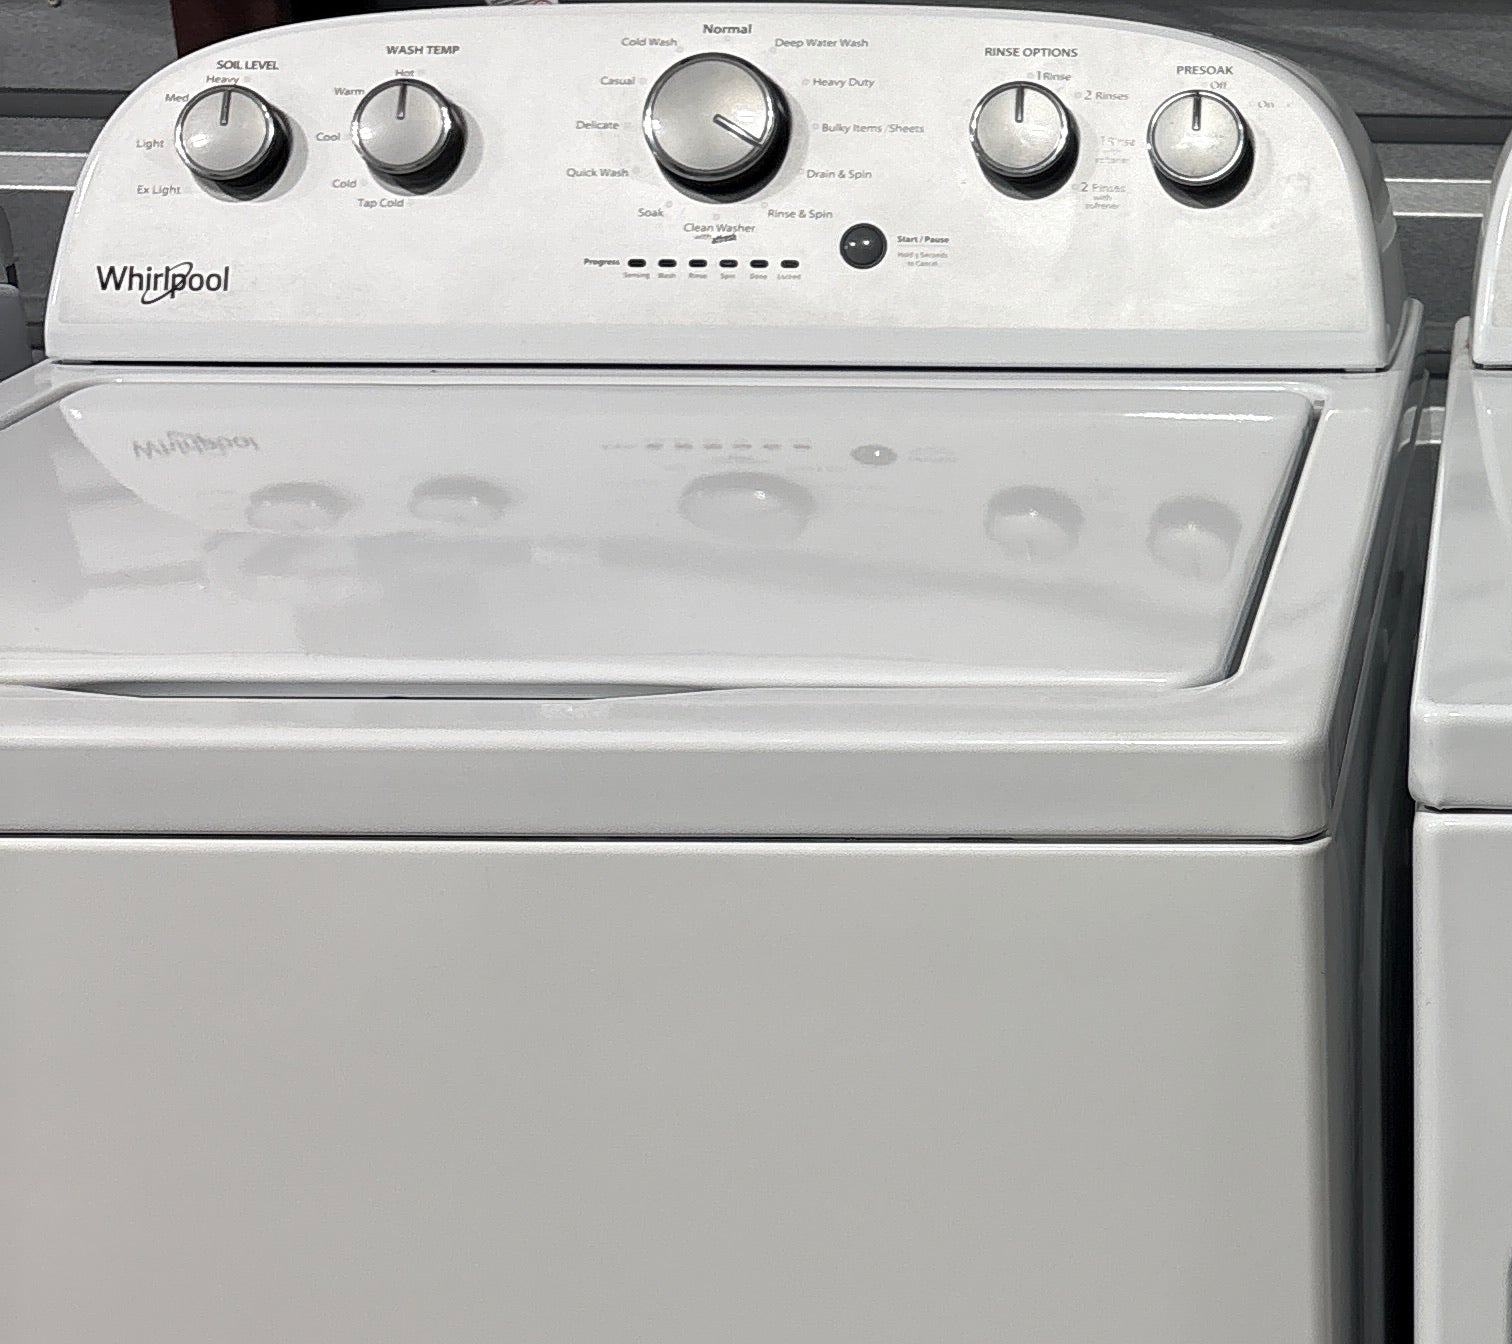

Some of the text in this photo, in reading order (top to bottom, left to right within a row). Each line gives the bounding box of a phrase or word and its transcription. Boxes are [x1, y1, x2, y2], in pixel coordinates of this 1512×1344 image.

[703, 24, 752, 35] Normal
[621, 37, 677, 46] Cold Wash
[775, 38, 869, 48] Deep Water Wash
[386, 46, 460, 55] WASH TEMP
[984, 47, 1078, 58] RINSE OPTIONS
[217, 60, 279, 70] SOIL LEVEL
[1176, 65, 1234, 75] PRESOAK
[395, 69, 414, 77] Hot
[1043, 72, 1072, 82] Rinse
[206, 75, 240, 85] Heavy
[600, 76, 636, 85] Casual
[813, 78, 875, 88] Heavy Duty
[1210, 81, 1227, 90] Off
[335, 87, 365, 95] Warm
[1084, 90, 1129, 100] 2 Rinses
[165, 94, 189, 102] Med
[1258, 100, 1275, 108] On
[576, 120, 620, 130] Delicate
[822, 123, 850, 133] Bulky
[853, 124, 882, 132] Items
[316, 132, 340, 142] Cool
[136, 140, 164, 150] Light
[566, 168, 629, 177] Quick Wash
[807, 170, 872, 181] Drain & Spin
[332, 179, 357, 188] Cold
[1080, 182, 1088, 192] 2
[137, 185, 181, 196] Ex Light
[358, 198, 404, 208] Tap Cold
[638, 208, 664, 217] Soak
[768, 209, 833, 220] Rinse & Spin
[683, 223, 756, 233] Clean Washer
[897, 235, 918, 243] Start
[584, 258, 620, 267] Progress
[96, 262, 230, 305] Whirlpool
